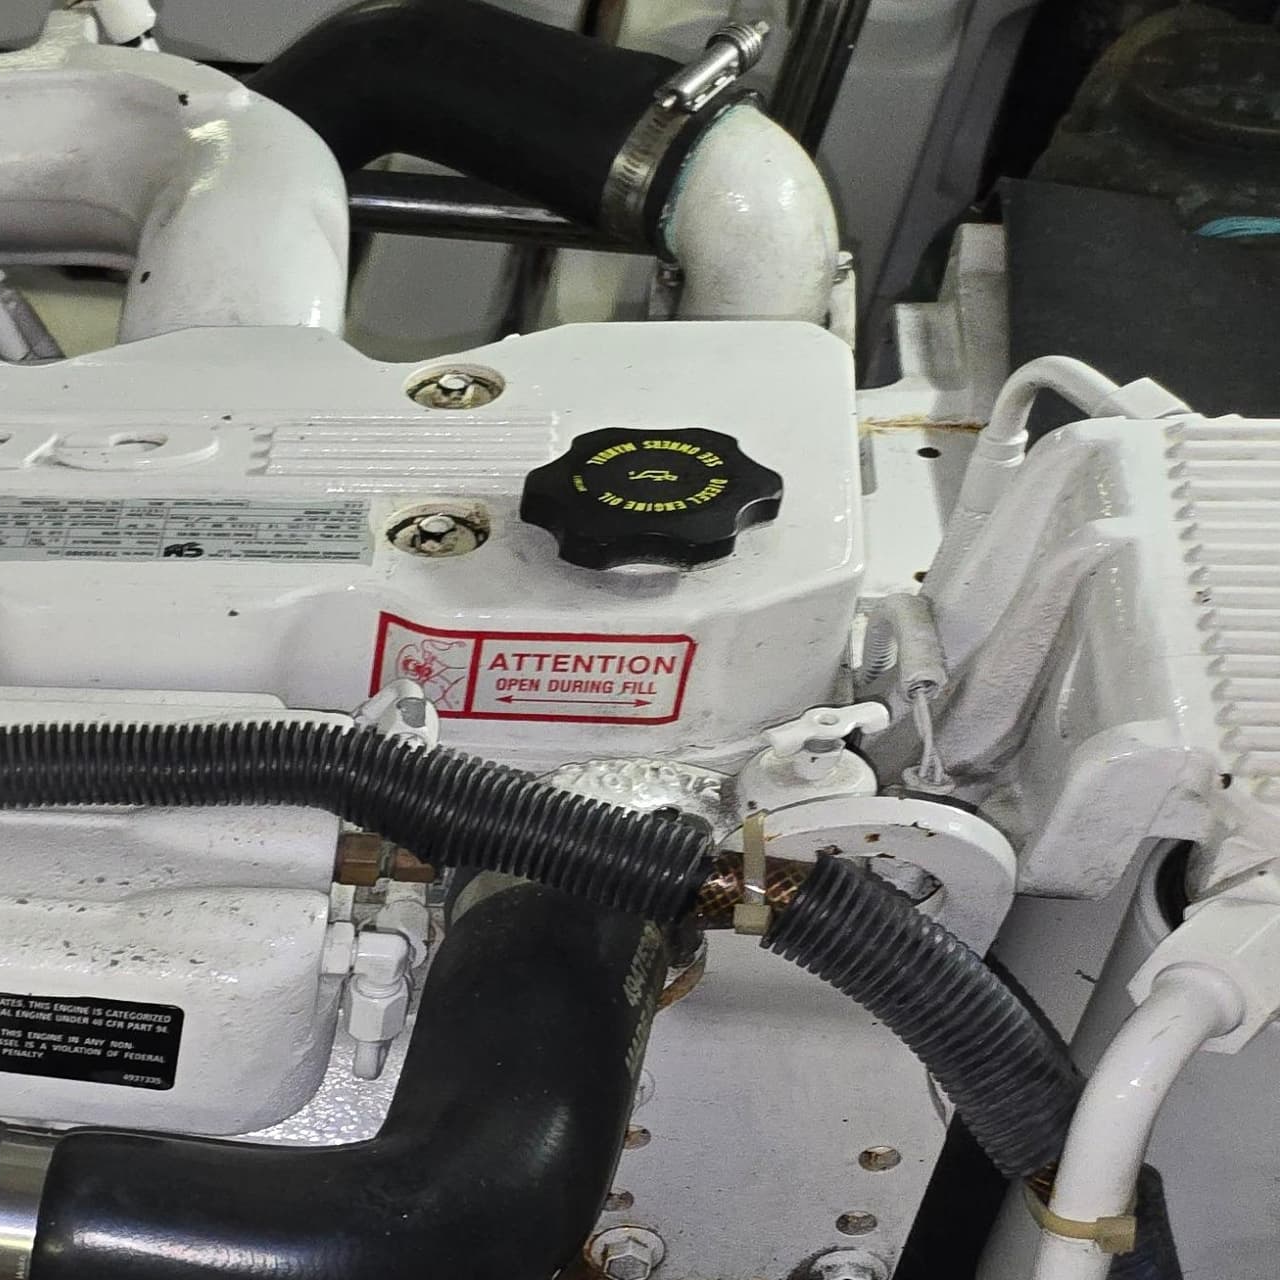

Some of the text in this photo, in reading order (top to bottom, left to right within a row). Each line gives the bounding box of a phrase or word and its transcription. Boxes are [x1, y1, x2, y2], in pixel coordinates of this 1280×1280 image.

[488, 652, 678, 676] ATTENTION
[495, 678, 658, 696] OPEN DURING FILL
[15, 1010, 52, 1021] ENGINE
[55, 1014, 89, 1025] UNDER
[127, 1022, 154, 1033] PART
[28, 1000, 51, 1011] THIS
[53, 1003, 90, 1015] ENGINE
[105, 1008, 172, 1023] CATEGORIZED
[1, 1028, 22, 1038] THIS
[27, 1031, 63, 1042] ENGINE
[68, 1036, 80, 1044] IN
[84, 1037, 106, 1047] ANY
[52, 1044, 102, 1056] VIOLATION
[106, 1050, 119, 1058] OF
[124, 1052, 165, 1063] FEDERAL
